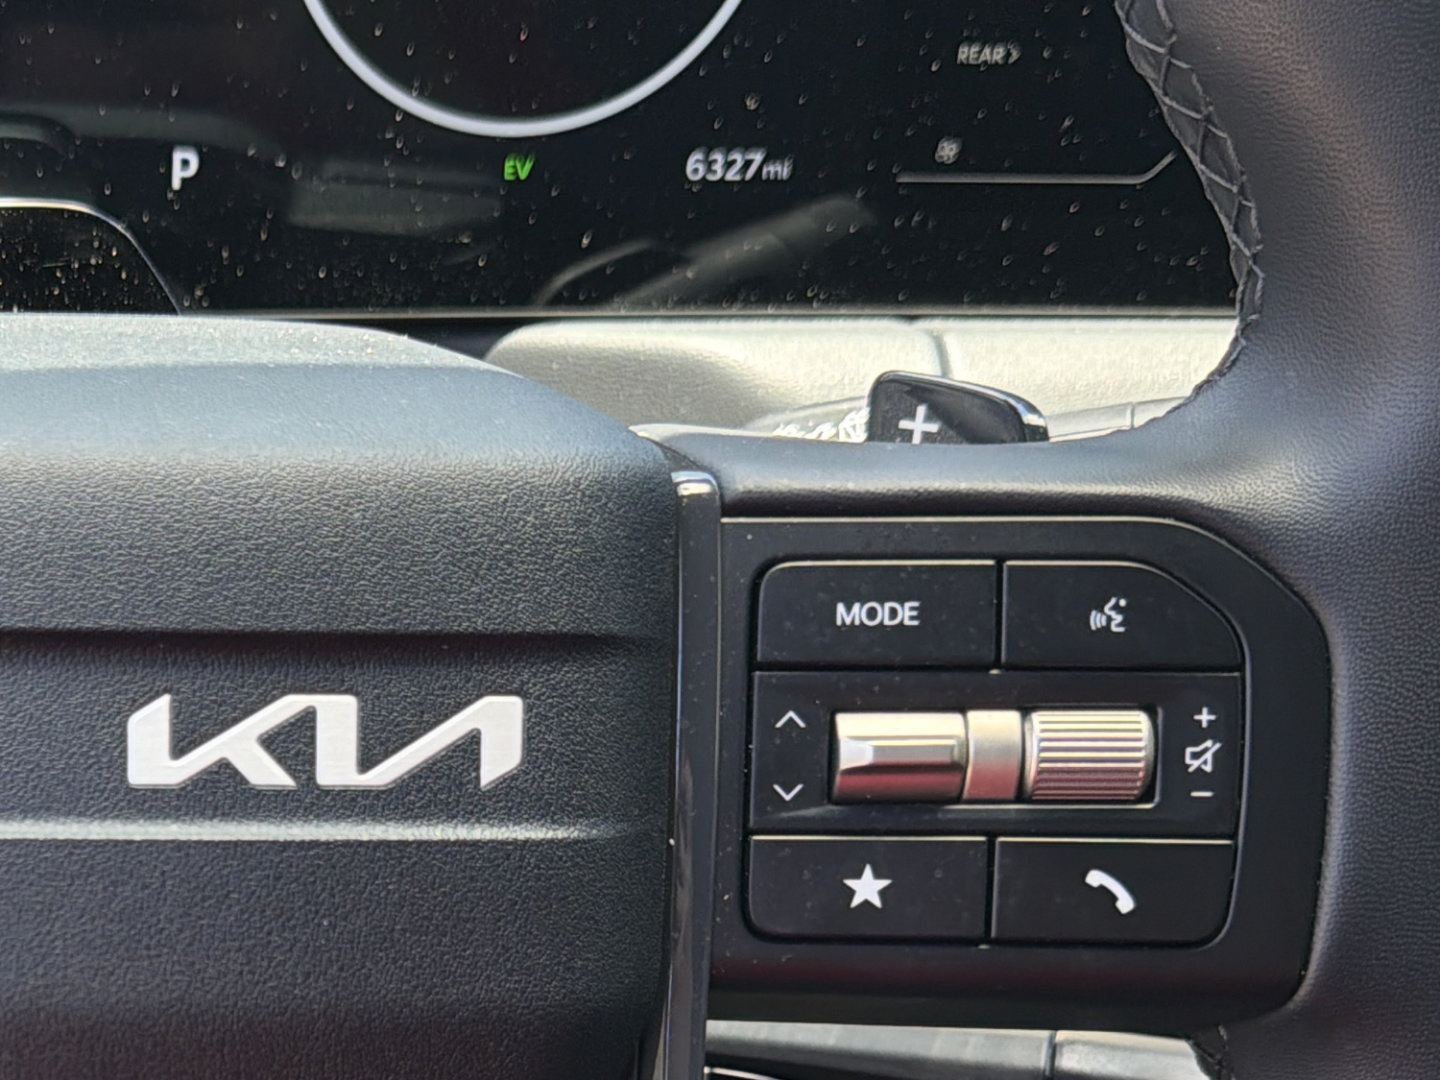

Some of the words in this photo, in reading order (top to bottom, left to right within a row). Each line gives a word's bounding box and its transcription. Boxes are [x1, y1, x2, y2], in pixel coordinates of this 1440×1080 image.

[172, 148, 199, 190] P
[504, 155, 534, 181] EV
[836, 601, 919, 626] MODE
